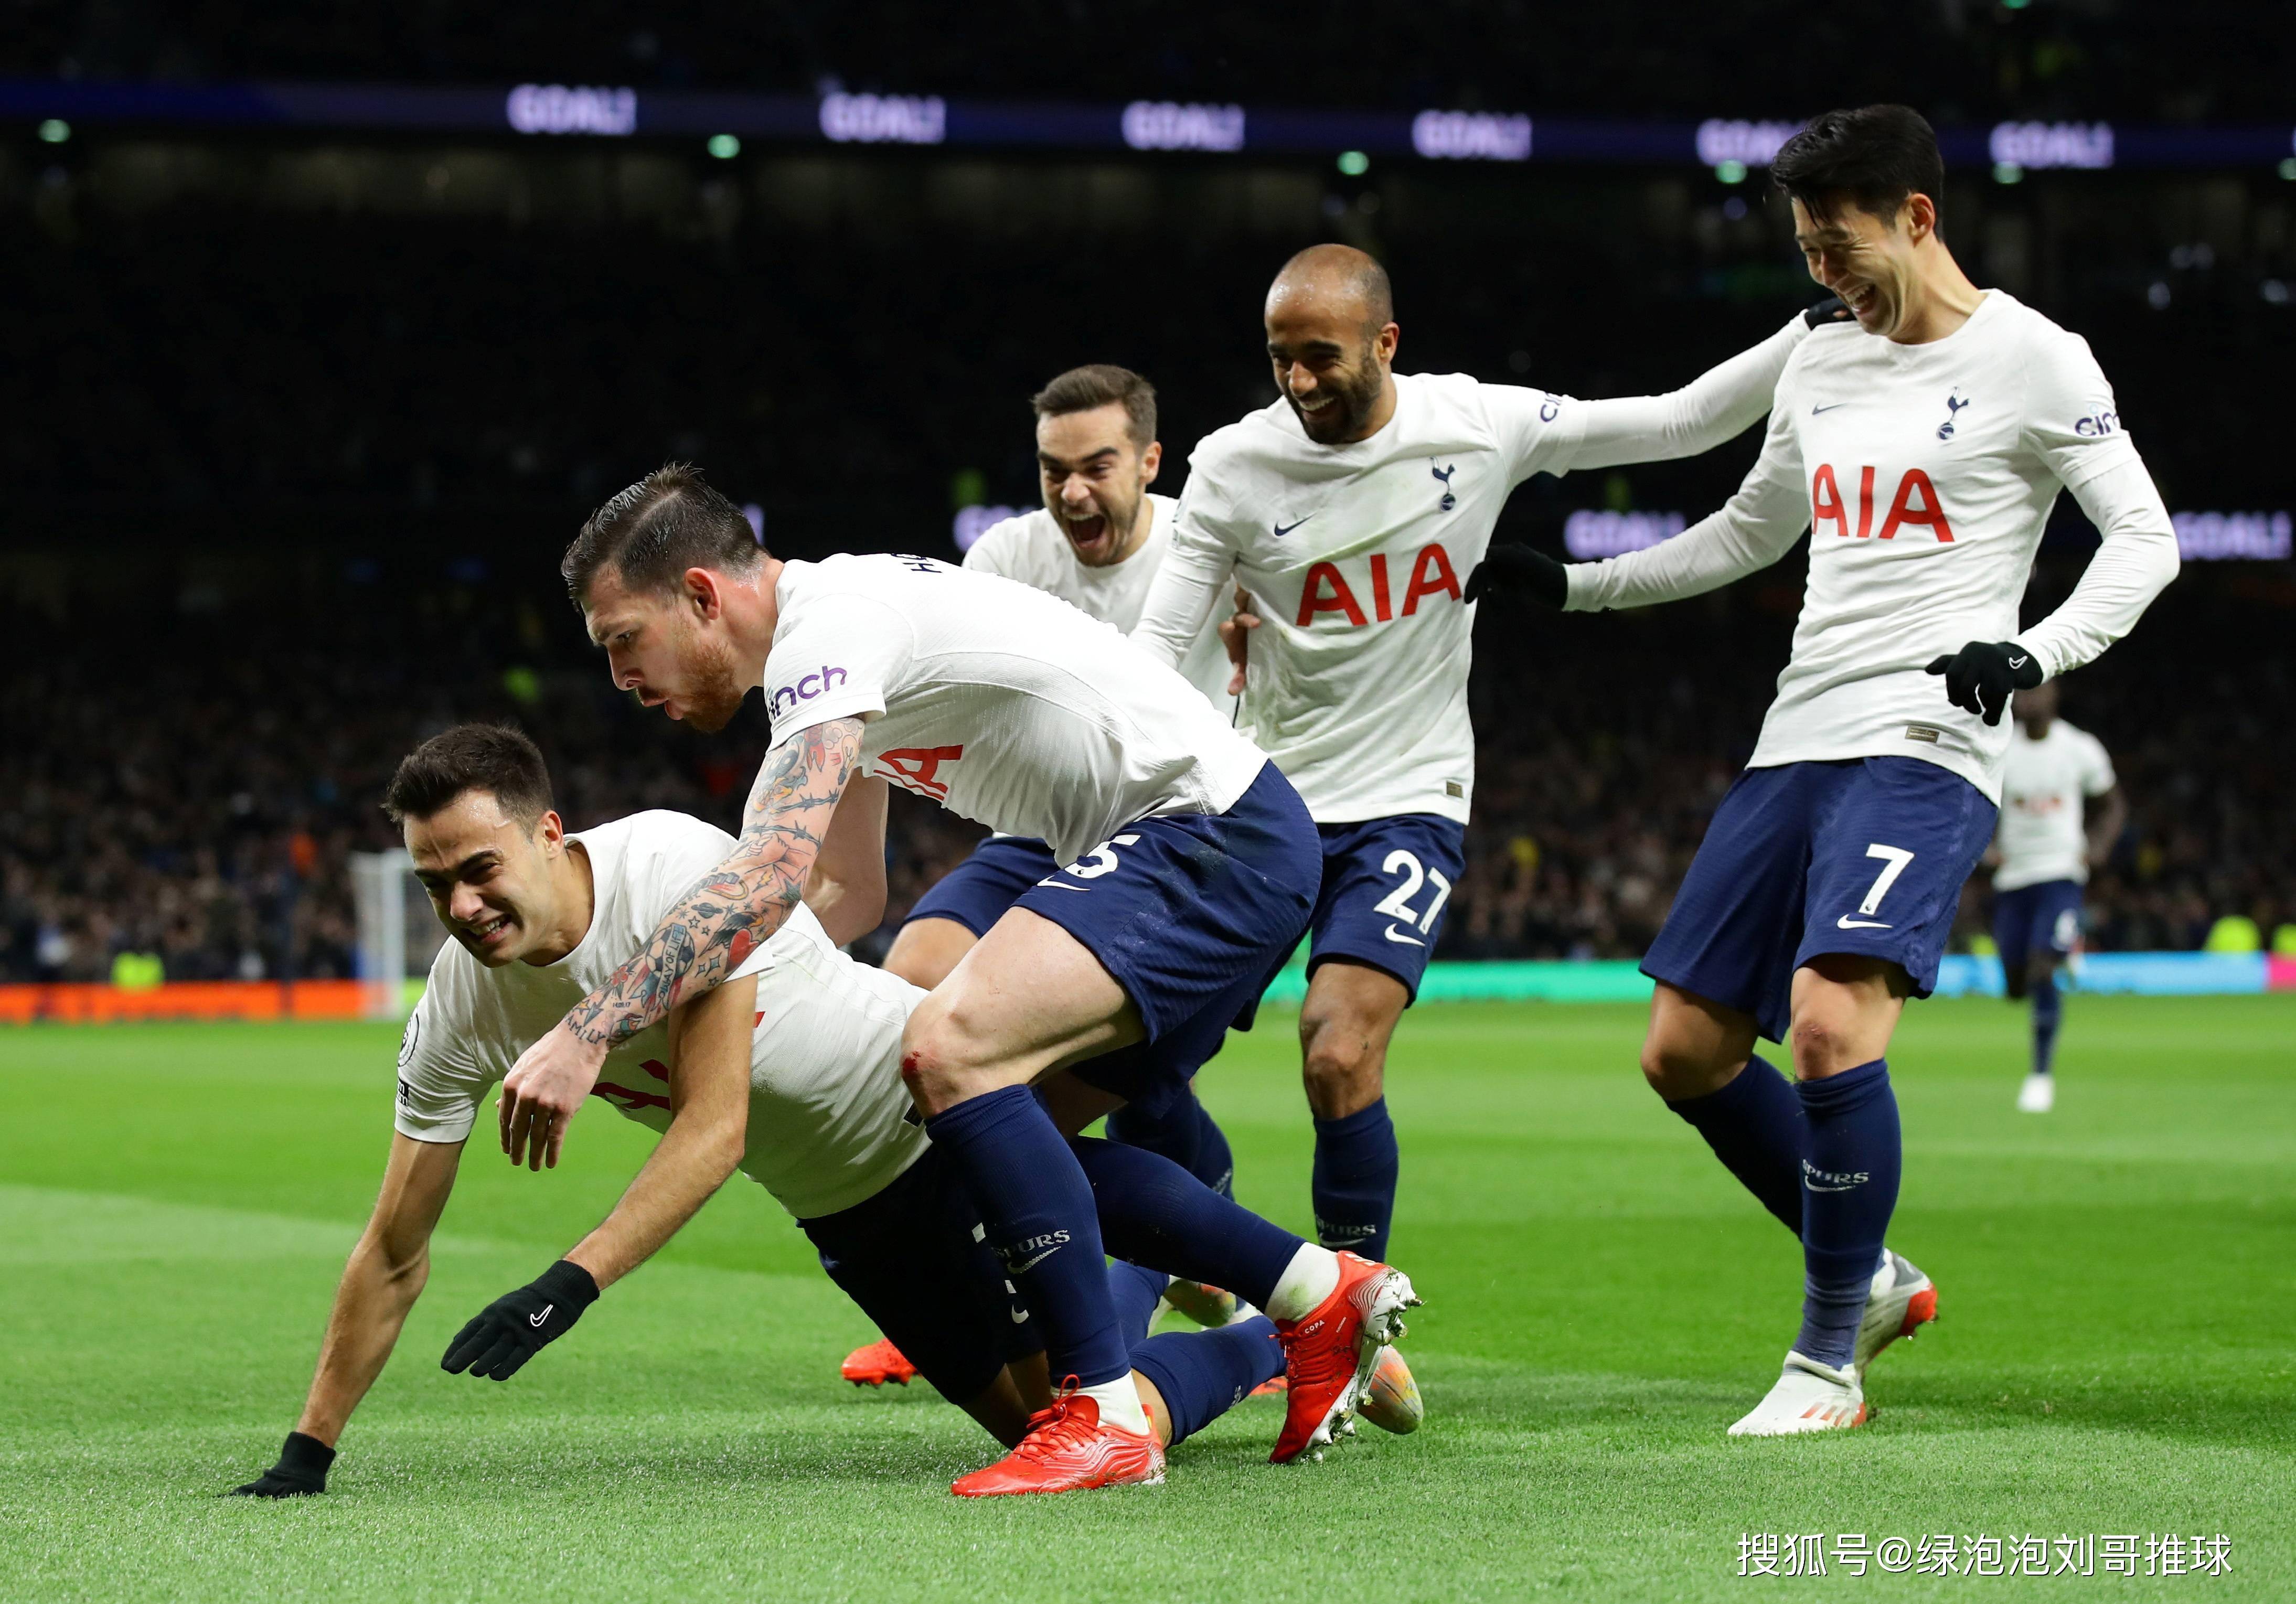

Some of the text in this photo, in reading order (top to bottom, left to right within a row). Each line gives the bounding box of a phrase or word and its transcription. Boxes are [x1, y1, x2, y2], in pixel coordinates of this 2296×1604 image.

[1696, 120, 1808, 167] GOA
[2075, 403, 2119, 436] cin
[1813, 464, 1954, 542] AIA
[1296, 543, 1461, 627] AIA
[768, 666, 847, 720] inch
[1064, 835, 1141, 879] 5
[1866, 843, 1915, 916] 7
[1373, 849, 1453, 935] 27
[565, 1014, 606, 1044] AMILY
[1305, 1320, 1325, 1334] COPA
